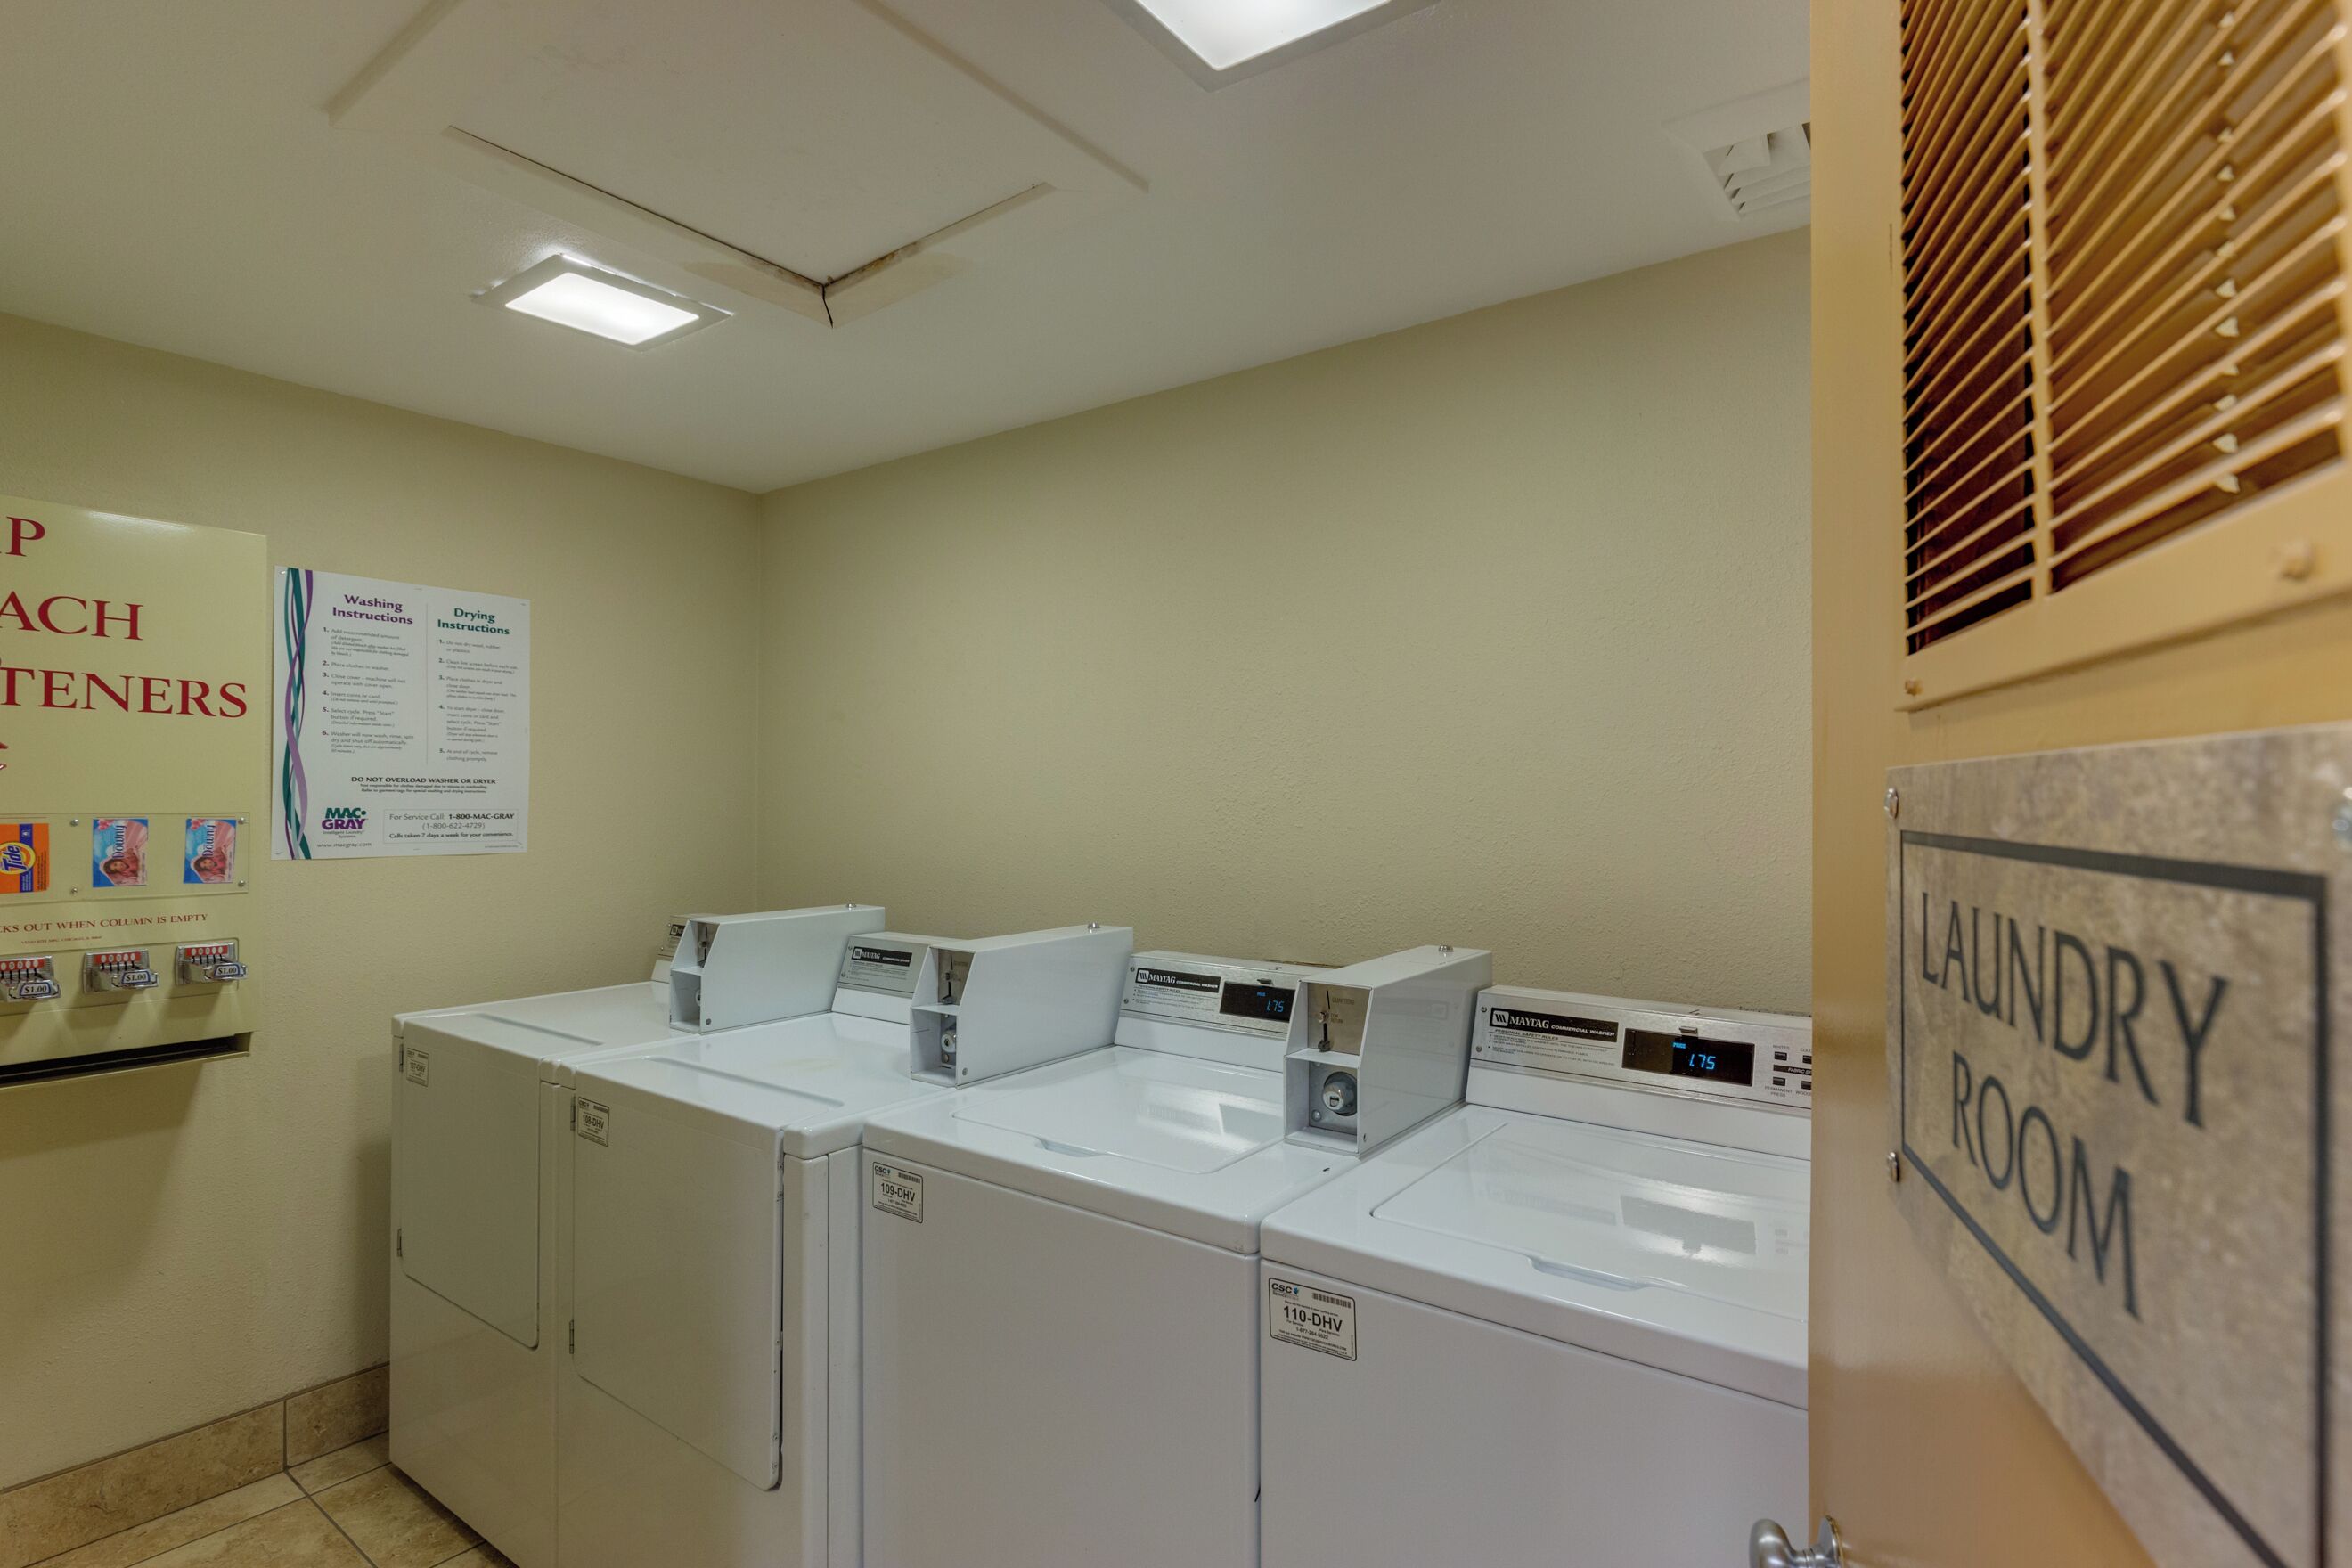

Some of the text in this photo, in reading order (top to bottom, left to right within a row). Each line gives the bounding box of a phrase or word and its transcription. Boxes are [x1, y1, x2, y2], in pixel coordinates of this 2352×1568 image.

[344, 594, 404, 613] Washing
[332, 607, 413, 625] Instructions
[454, 608, 495, 624] Drying
[437, 619, 510, 635] Instructions
[322, 819, 365, 830] GRAY
[422, 822, 485, 830] (1-800-622-4729)
[112, 825, 127, 859] Downy
[202, 825, 217, 858] Downy
[2, 845, 28, 871] Tide
[0, 925, 19, 933] KS
[24, 923, 52, 932] OUT
[56, 920, 96, 929] WHEN
[100, 917, 153, 927] COLUMN
[171, 913, 208, 923] EMPTY
[861, 951, 880, 960] MAYTAG
[125, 973, 146, 981] $1.00
[1148, 973, 1176, 984] MAYTAG
[24, 986, 47, 994] $1.00
[1922, 891, 2232, 1129] LAUNDRY
[1509, 1015, 1550, 1029] MAYTAG
[1551, 1025, 1588, 1033] COMMERCIAL
[881, 1183, 915, 1201] 109-DHV
[1951, 1049, 2143, 1322] ROOM
[1272, 1283, 1292, 1294] CSC
[1284, 1306, 1342, 1332] 110-DHV
